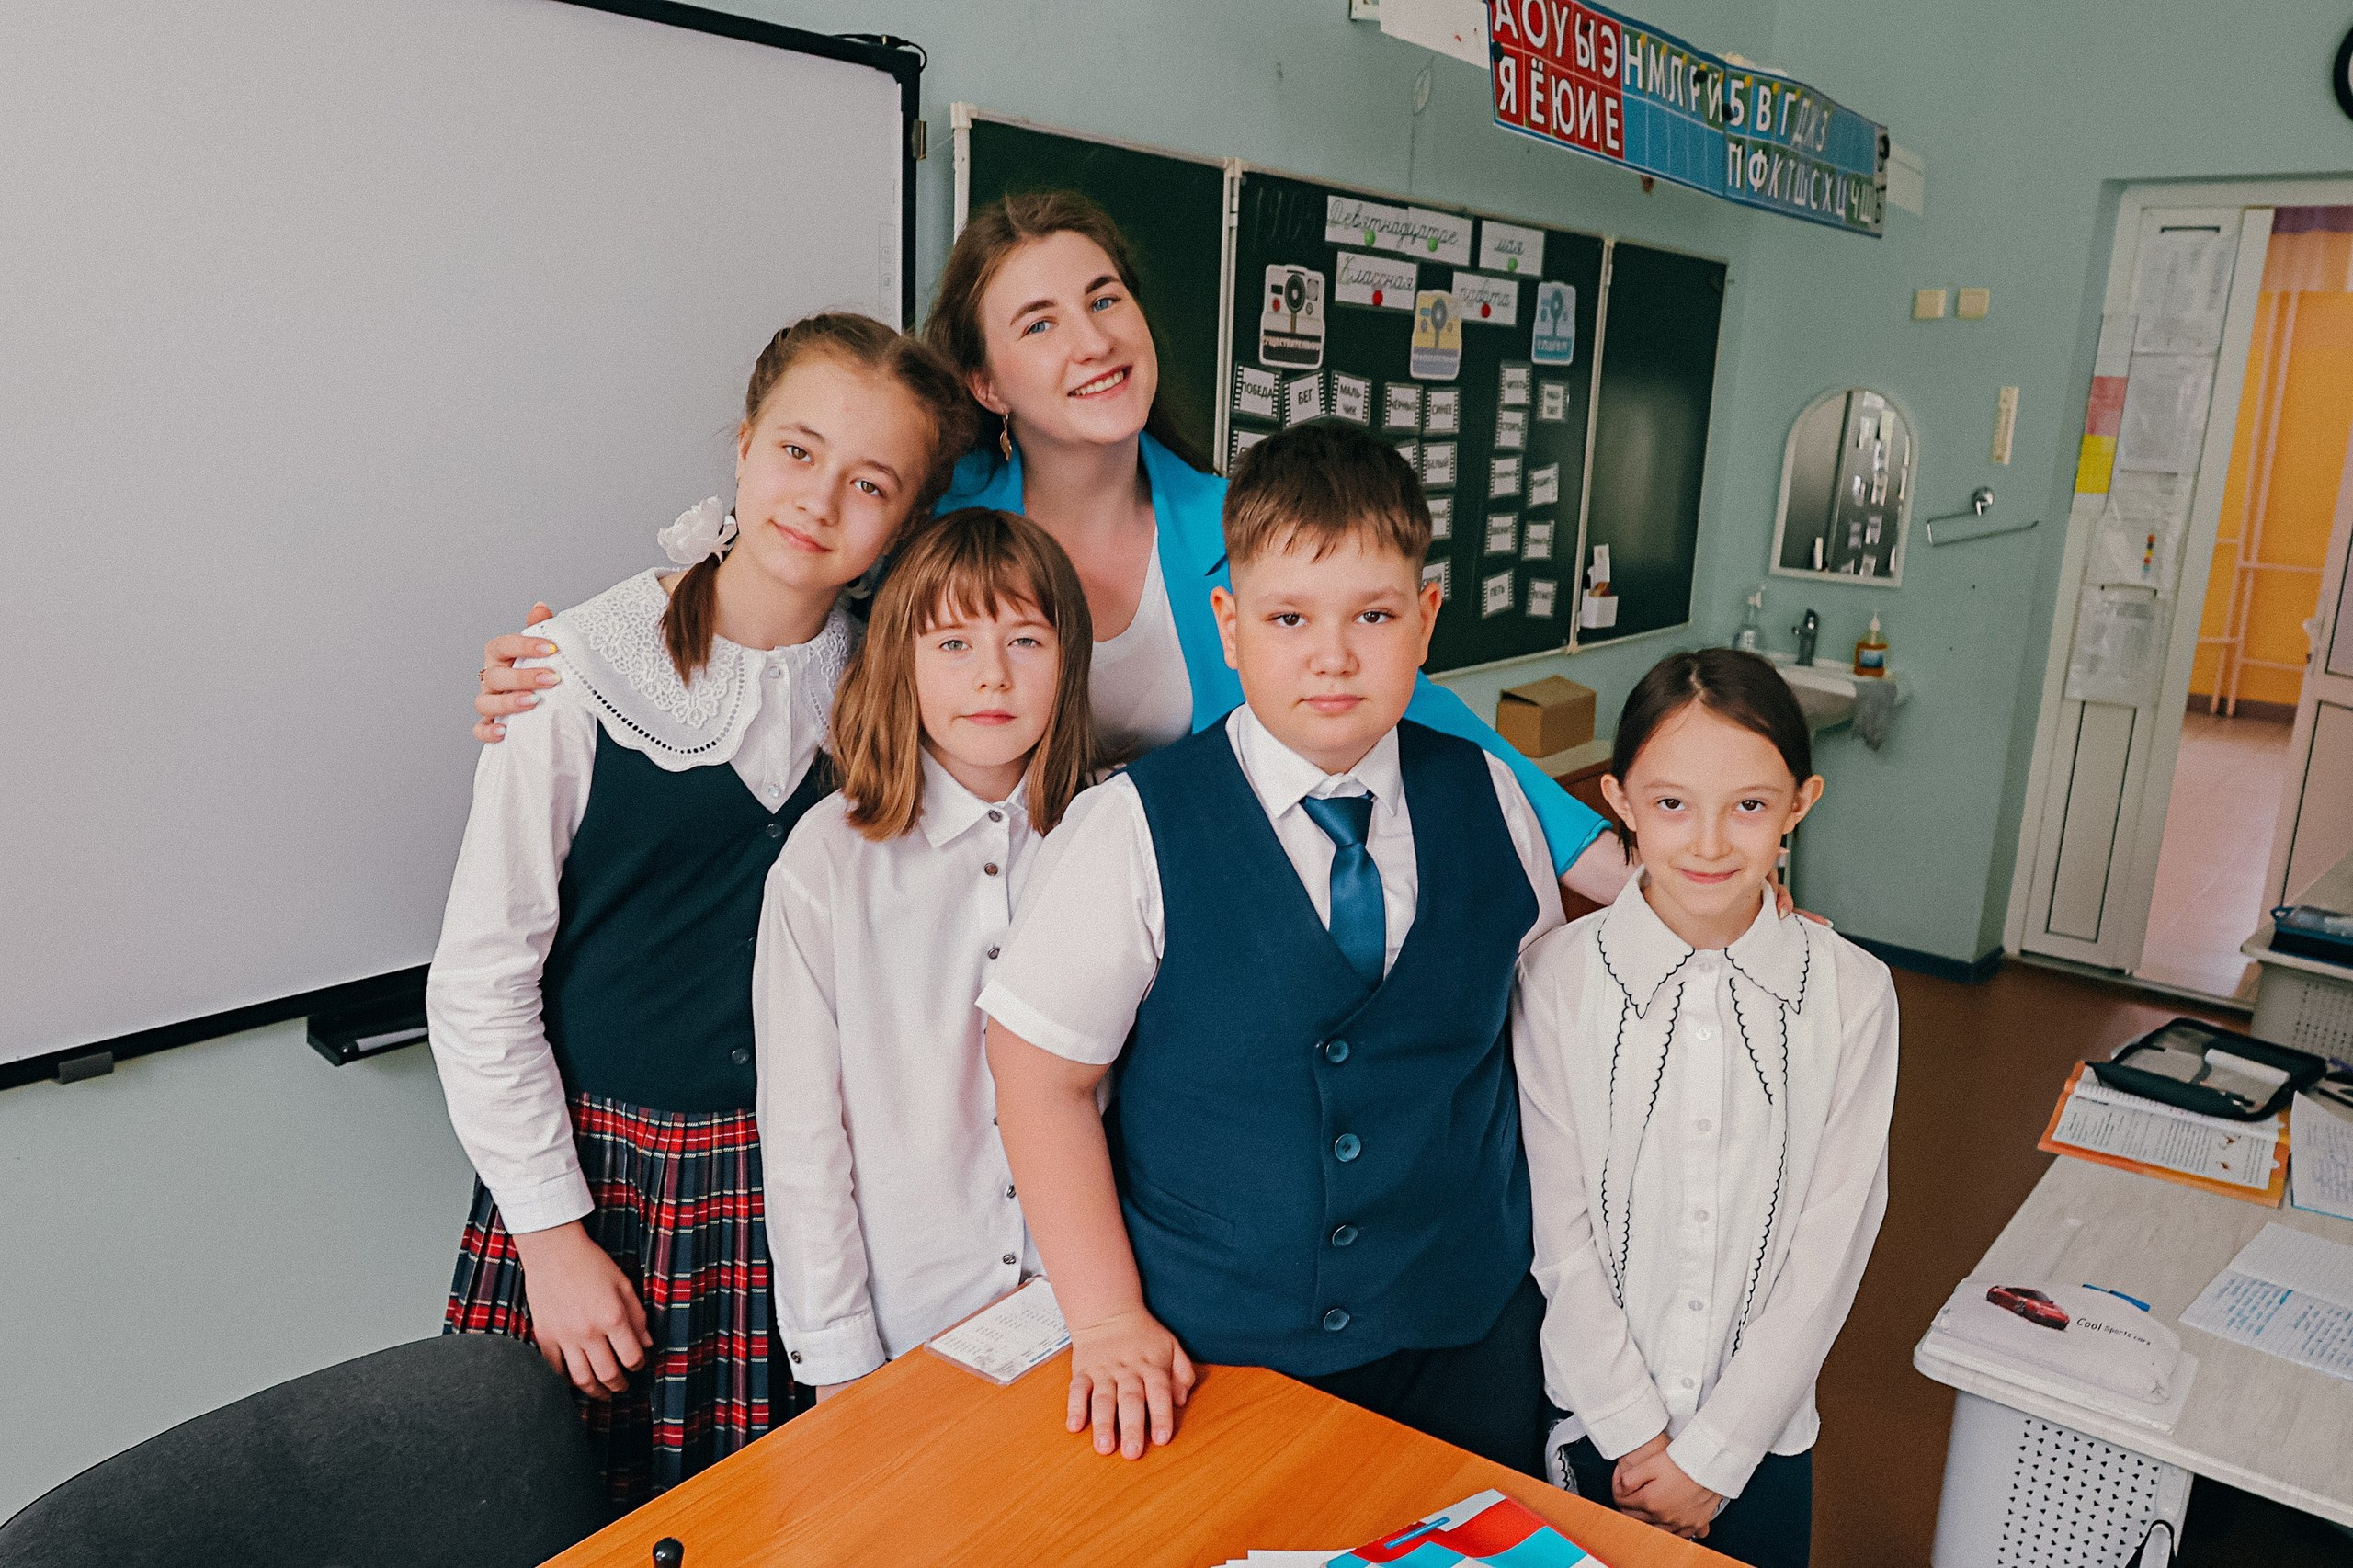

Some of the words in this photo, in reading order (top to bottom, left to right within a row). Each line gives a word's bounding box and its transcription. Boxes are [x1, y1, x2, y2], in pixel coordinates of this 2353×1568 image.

[1338, 255, 1415, 292] Классная
[1241, 382, 1274, 399] ПОБЕДА
[1297, 389, 1313, 405] БЕГ
[2076, 1317, 2103, 1331] Cool
